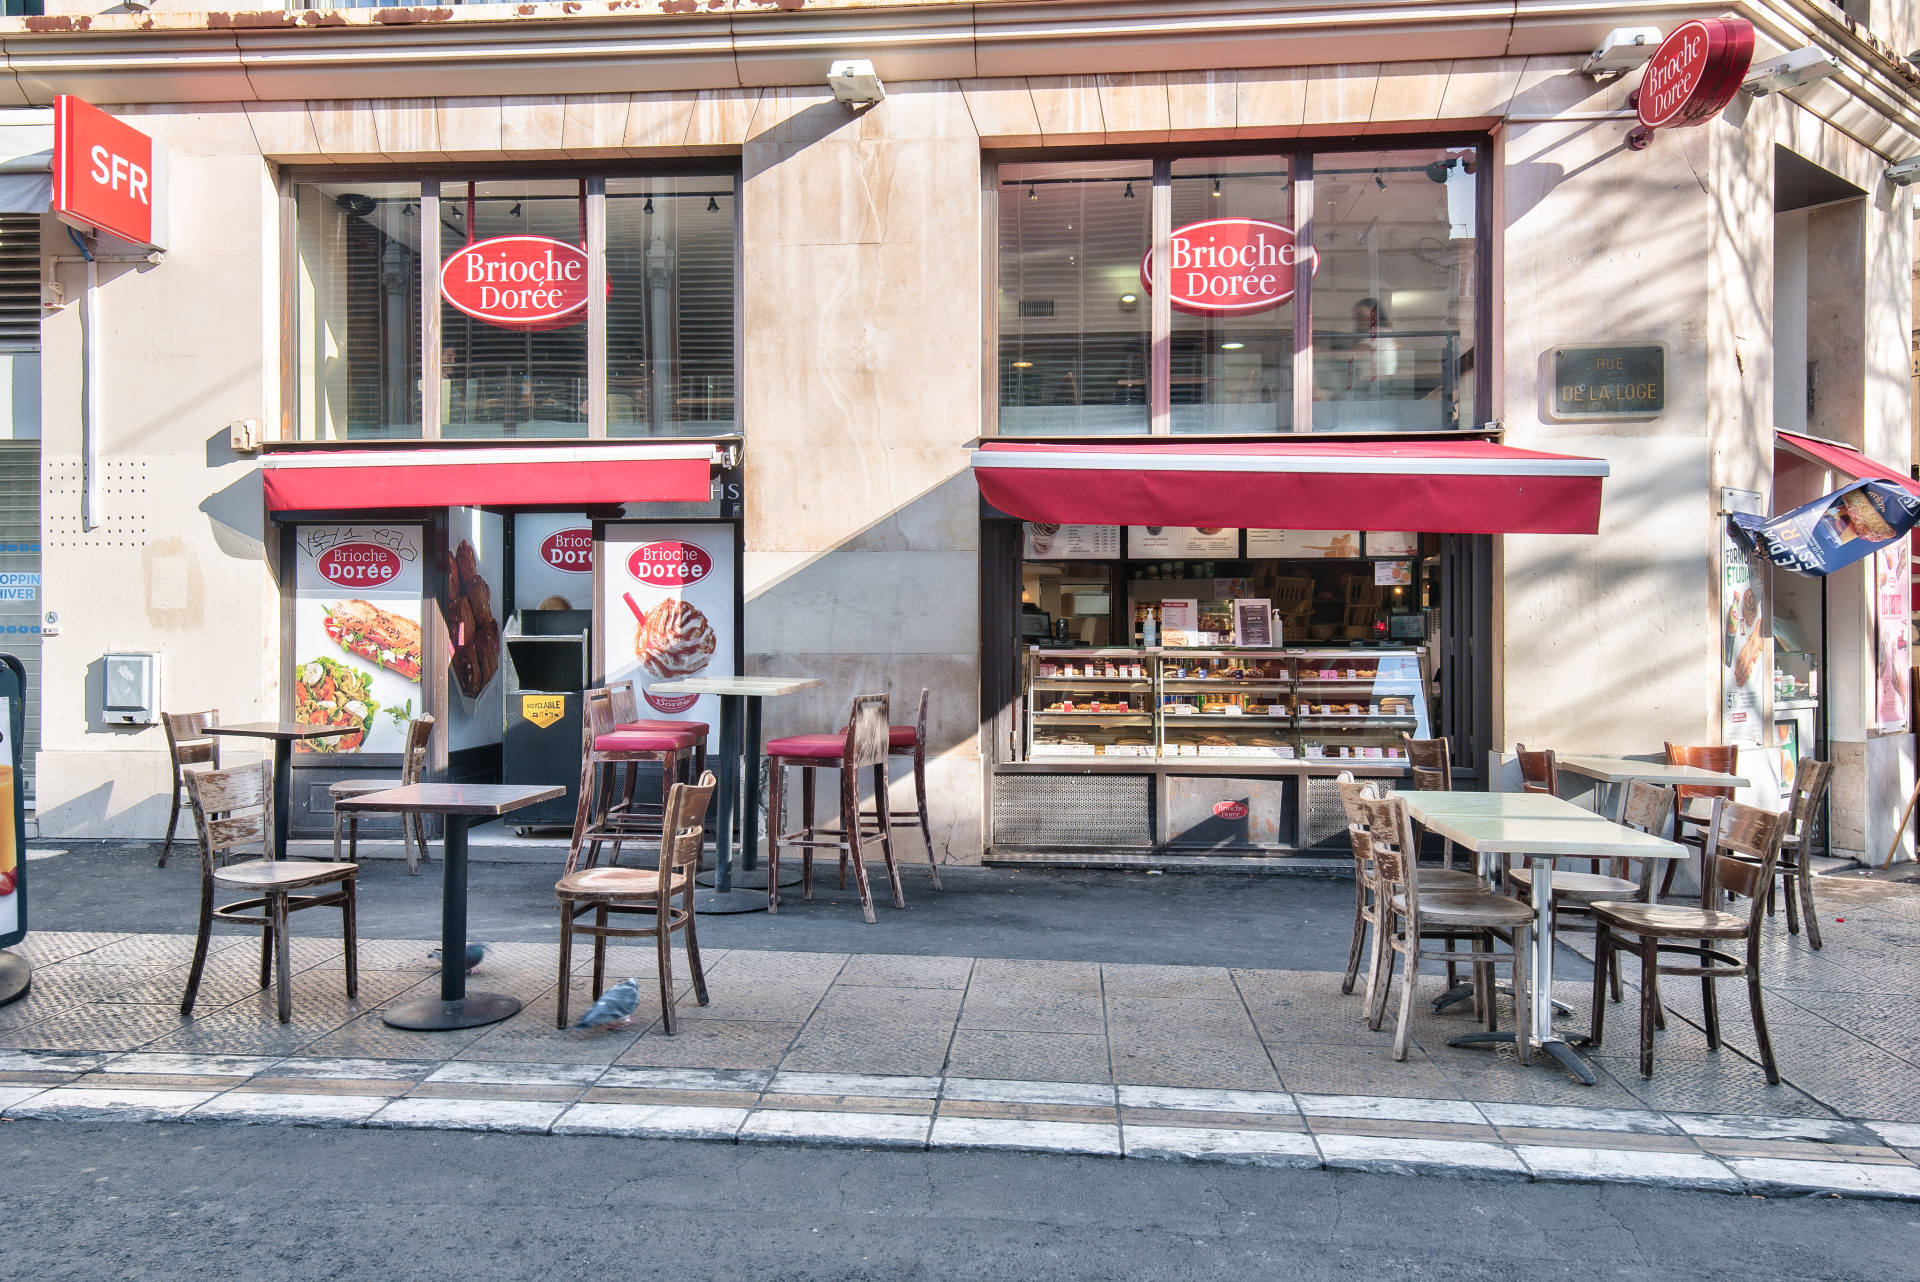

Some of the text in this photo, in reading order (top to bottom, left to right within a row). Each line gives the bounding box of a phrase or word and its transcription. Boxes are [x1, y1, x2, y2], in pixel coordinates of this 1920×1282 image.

[1648, 36, 1701, 97] Brioche
[1654, 69, 1692, 118] Dorée
[91, 145, 148, 205] SFR
[1170, 233, 1294, 269] Brioche
[466, 250, 581, 282] Brioche
[1186, 266, 1276, 296] Dorée
[480, 280, 562, 309] Dorée
[1596, 358, 1623, 370] RUE
[1563, 384, 1656, 402] DE LA LOGE
[334, 549, 387, 562] Brioche
[642, 547, 698, 560] Brioche
[1774, 554, 1802, 572] LE
[1790, 544, 1820, 570] EST
[328, 564, 393, 578] Dorée
[638, 562, 703, 578] Dorée
[527, 700, 560, 708] RECYCLABLE
